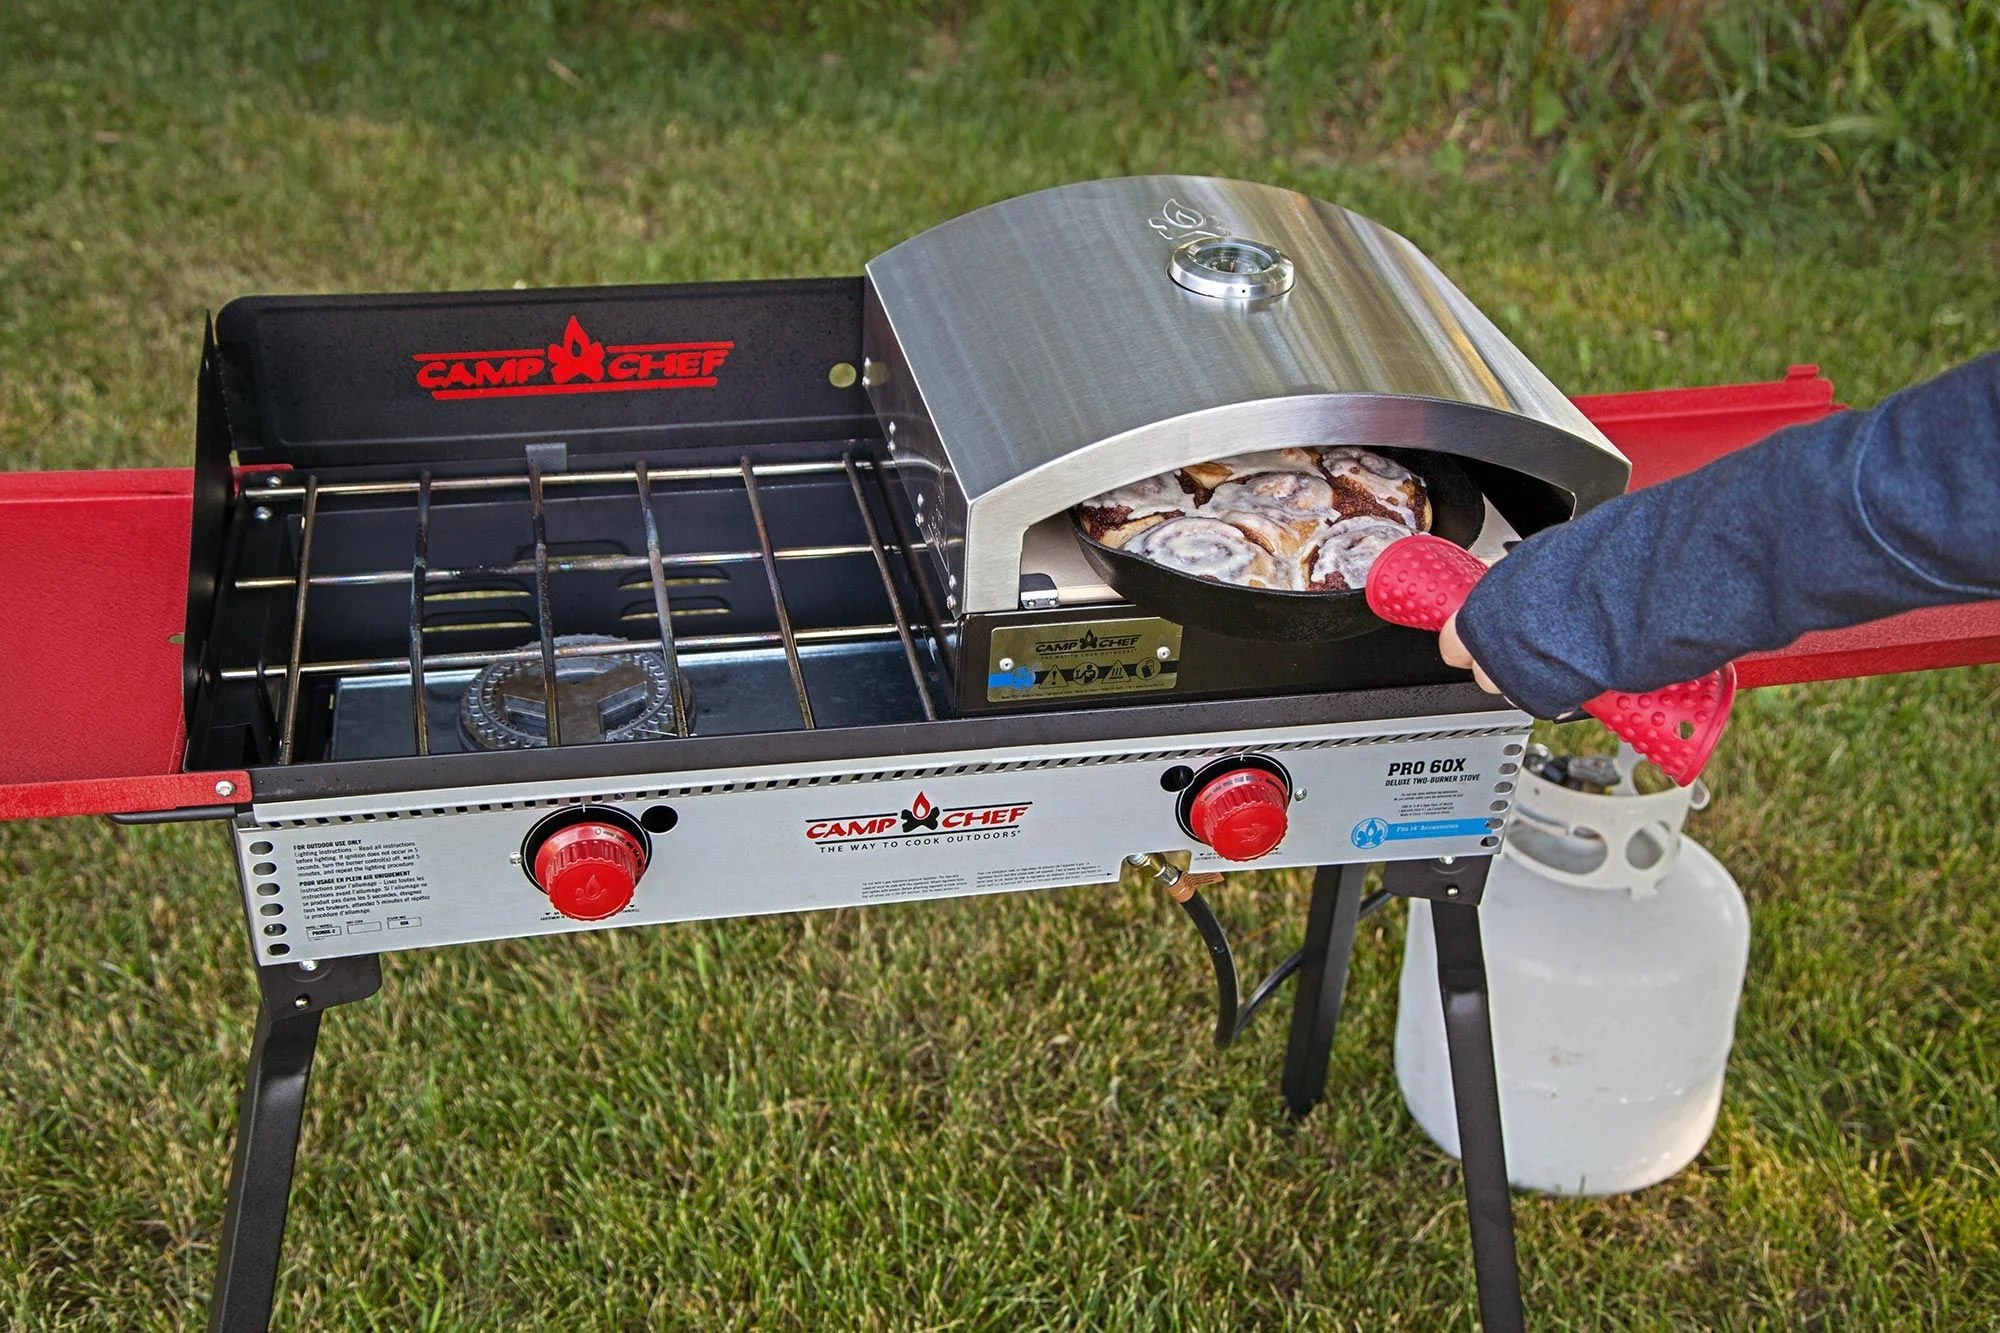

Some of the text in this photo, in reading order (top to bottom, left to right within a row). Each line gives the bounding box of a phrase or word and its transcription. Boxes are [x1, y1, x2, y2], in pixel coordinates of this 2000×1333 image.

[416, 350, 728, 388] CAMP CHEF
[1035, 637, 1140, 653] CAMP CHEF
[1387, 758, 1466, 776] PRO 60X
[1385, 774, 1480, 786] DELUXE TWO-BURNER STOVE
[806, 806, 1029, 839] CAMP CHEF
[820, 845, 844, 854] THE
[850, 842, 876, 851] WAY
[905, 837, 940, 846] COOK
[374, 870, 410, 879] UNIQUEMENT
